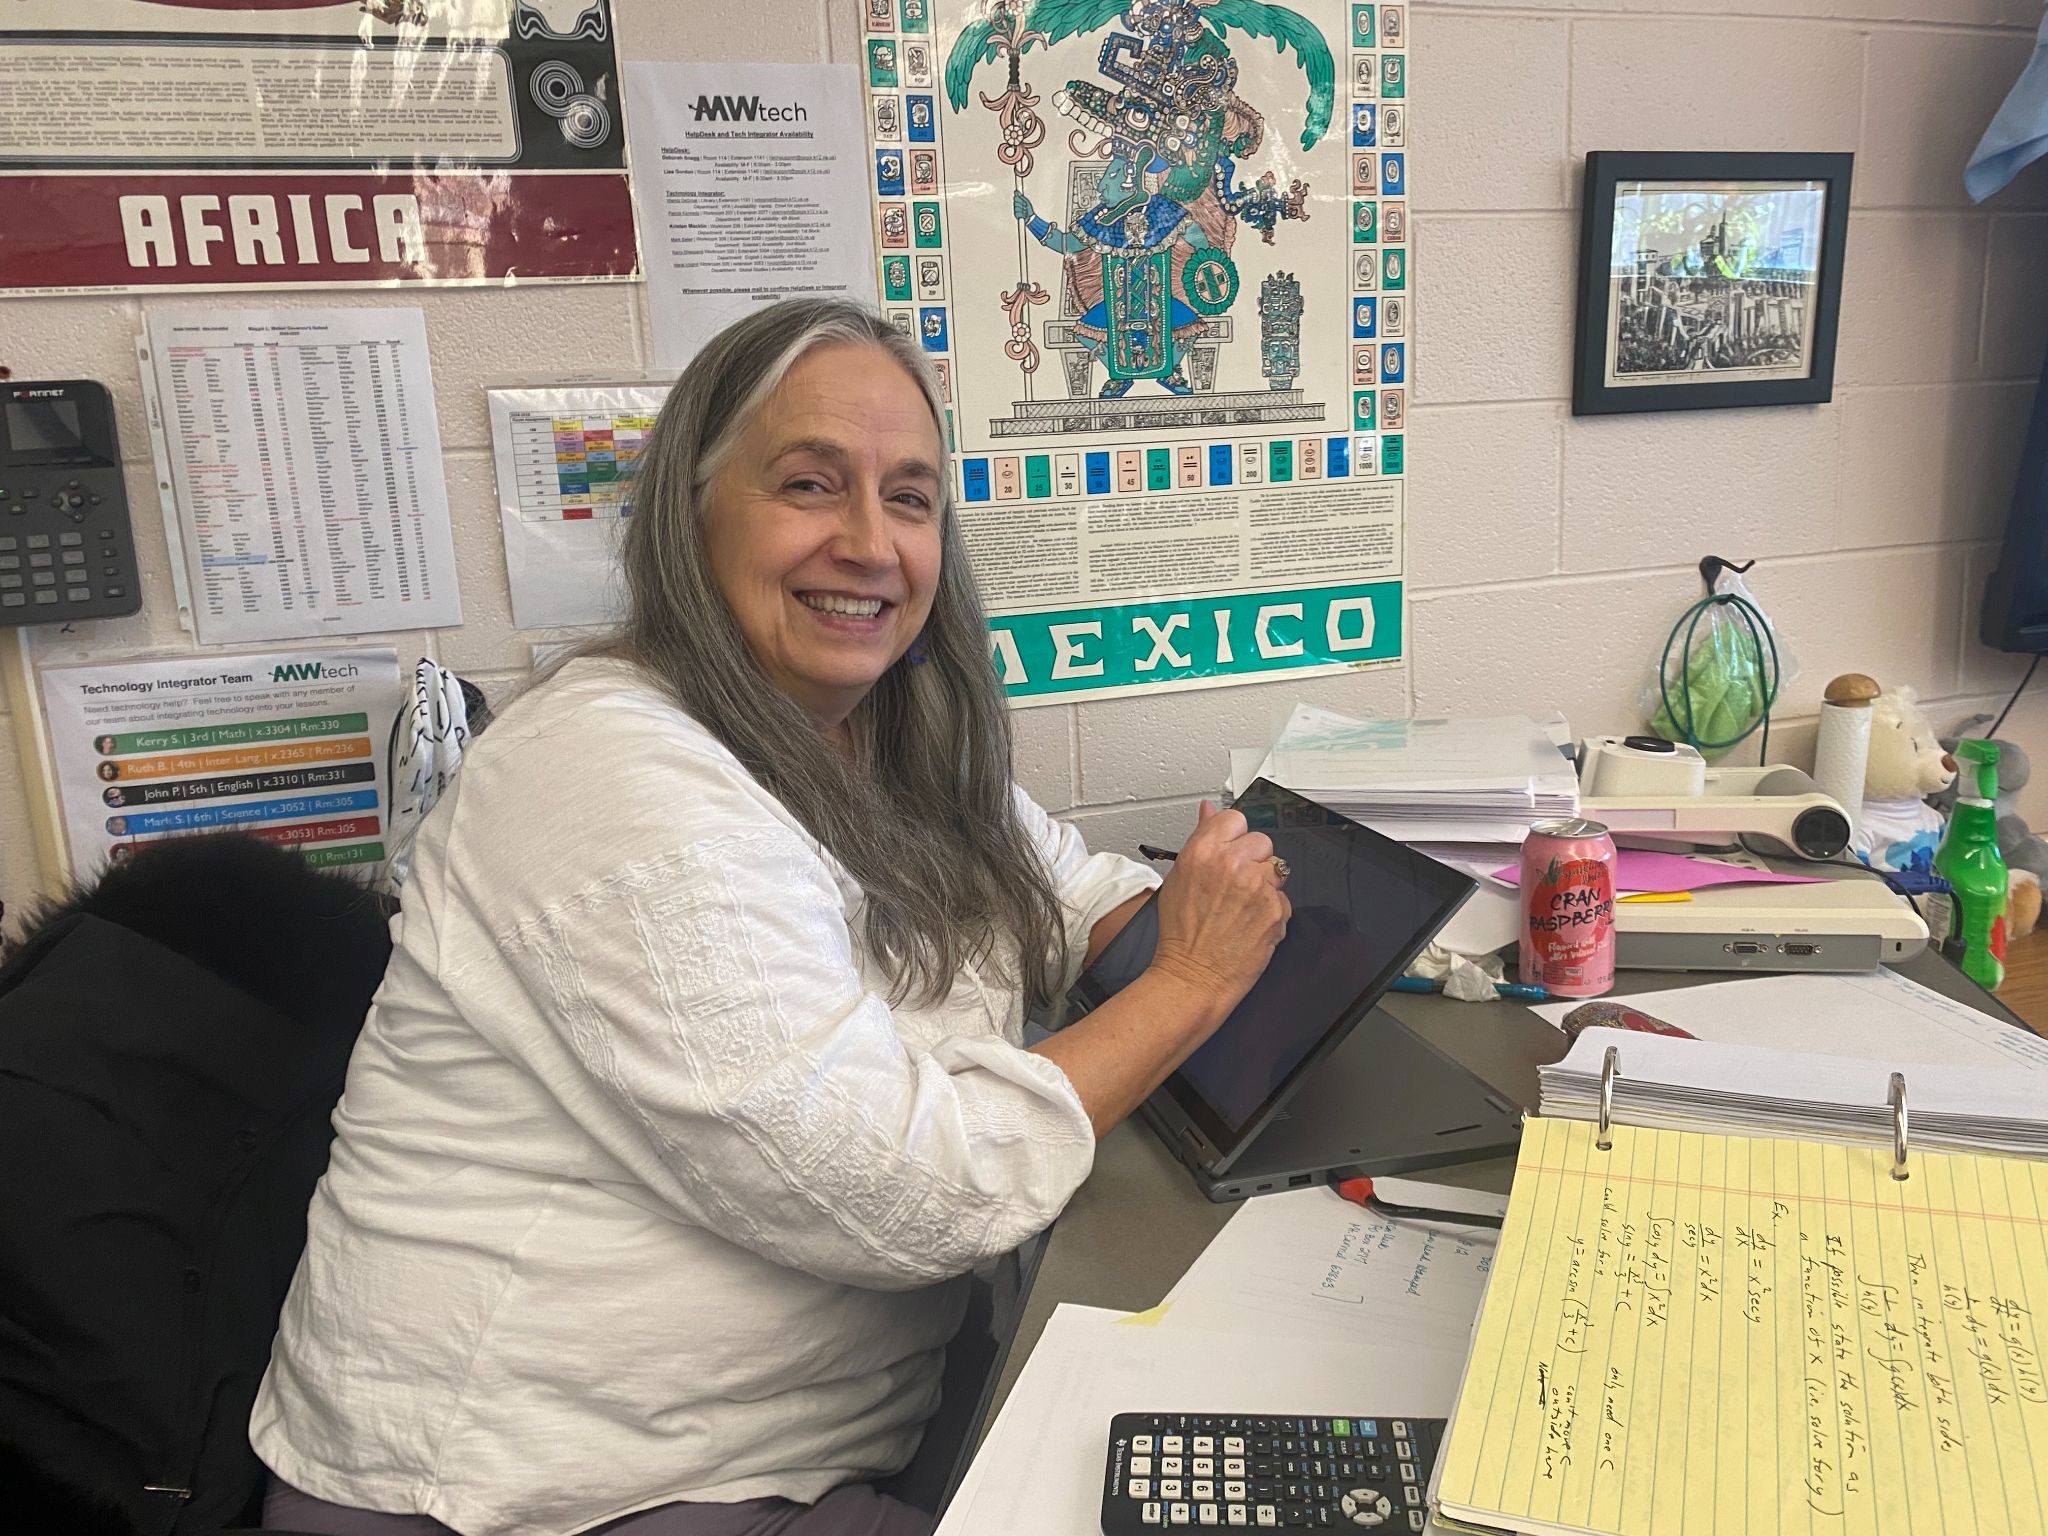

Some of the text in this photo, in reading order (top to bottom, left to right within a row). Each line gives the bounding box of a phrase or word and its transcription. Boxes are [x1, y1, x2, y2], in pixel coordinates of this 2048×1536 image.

[119, 195, 425, 267] AFRICA
[1004, 486, 1012, 494] 20
[80, 673, 253, 695] Technology Integrator Team
[84, 704, 108, 714] Need
[110, 701, 161, 713] technology
[163, 699, 188, 709] help?
[193, 696, 212, 705] Feel
[244, 692, 271, 703] speak
[272, 690, 290, 699] with
[292, 689, 308, 698] any
[310, 686, 345, 695] member
[346, 684, 355, 693] of
[85, 699, 330, 726] our team about integrating technology into your lessons.
[136, 720, 340, 748] Kerry S. 3rd Math x.3304 Rm:330
[128, 763, 155, 774] Ruth
[157, 761, 168, 771] B.
[177, 759, 195, 769] 4th
[271, 749, 305, 760] x.2365
[315, 744, 354, 756] Rm:236
[144, 770, 345, 801] John P. 5th English x.3310 Rm:331
[144, 797, 354, 827] Mark S. 6th Science x.3052 Rm:305
[317, 824, 355, 836] Rm:305
[326, 849, 364, 862] Rm:131
[1530, 896, 1616, 931] RASPBERRY
[1550, 888, 1601, 910] CRAN
[1772, 1202, 1788, 1226] Ex.
[1600, 1218, 1611, 1240] solve
[1800, 1232, 1810, 1242] a
[1597, 1249, 1610, 1265] for
[1801, 1256, 1824, 1319] function
[1808, 1327, 1822, 1349] of
[1821, 1235, 1865, 1494] If possible state the solution as
[1907, 1254, 1966, 1453] Then integrate both sides
[1604, 1367, 1624, 1389] only
[1606, 1397, 1624, 1427] need
[1542, 1388, 1562, 1480] outside here
[1562, 1420, 1571, 1450] move
[1809, 1415, 1825, 1449] solve
[1112, 1448, 1125, 1496] TEXAS INSTRUMENTS
[1370, 1466, 1378, 1474] del
